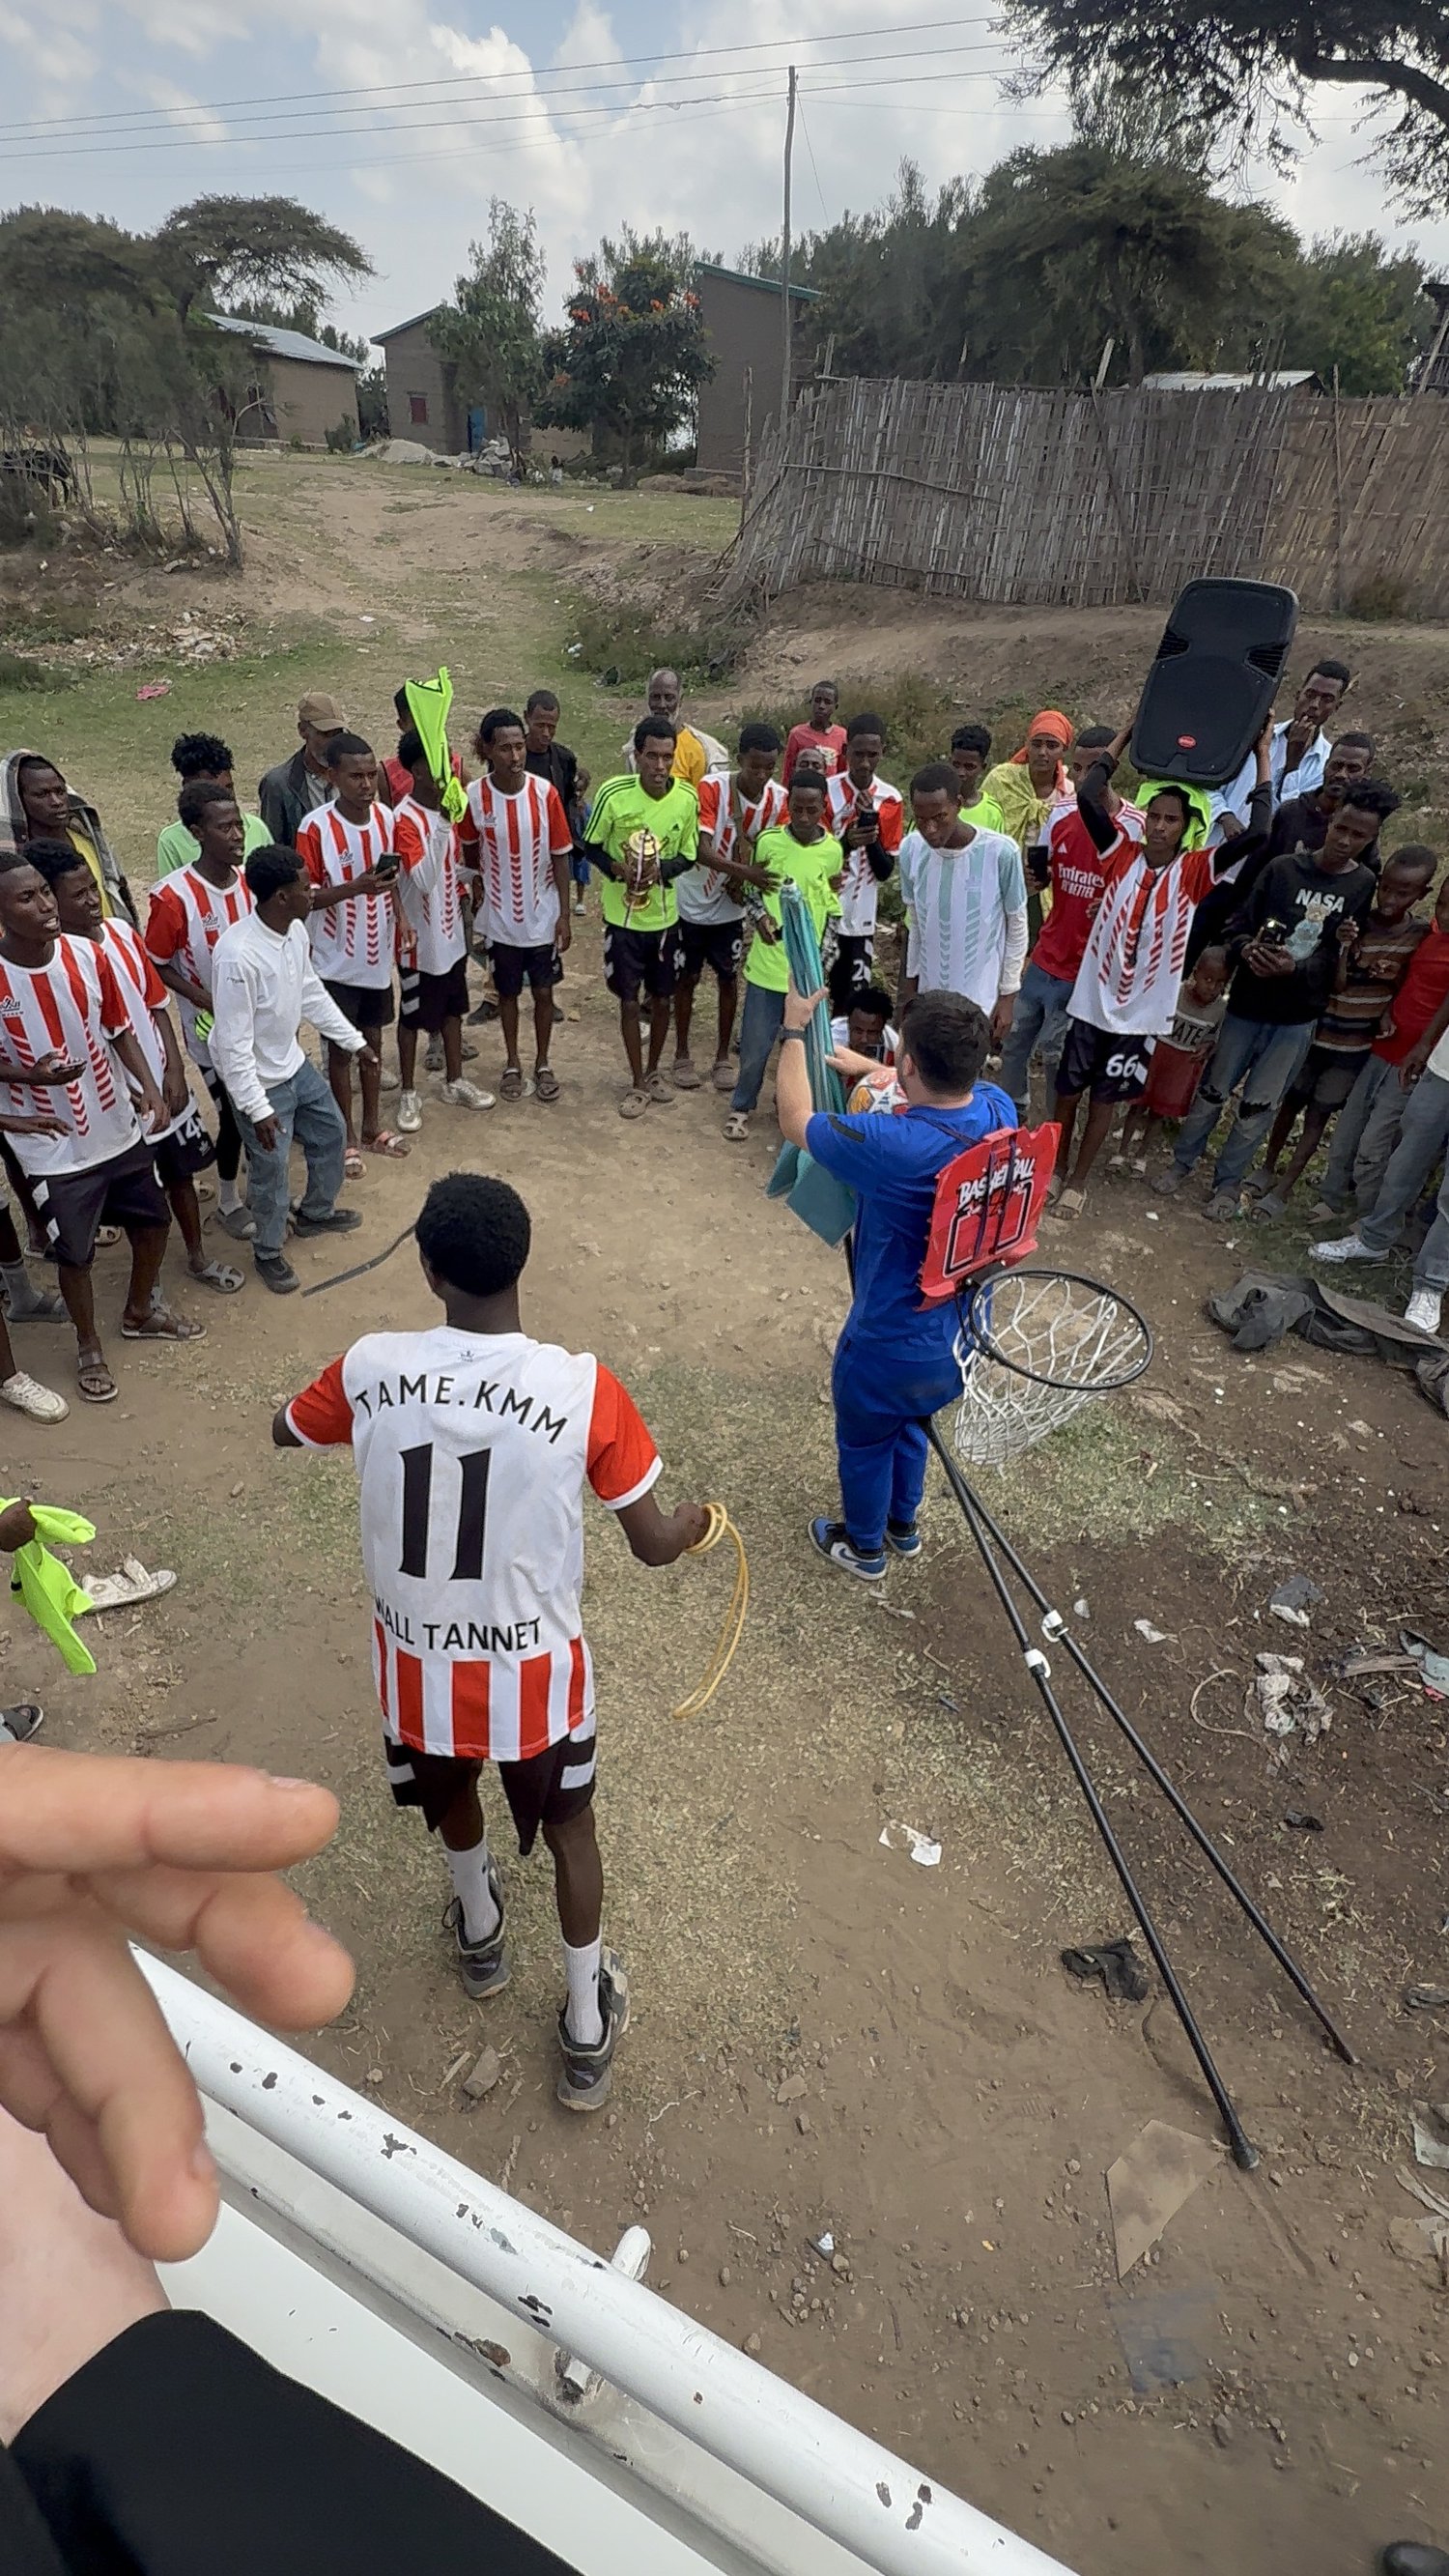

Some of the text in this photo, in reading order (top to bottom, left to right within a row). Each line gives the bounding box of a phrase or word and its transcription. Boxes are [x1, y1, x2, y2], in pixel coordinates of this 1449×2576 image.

[1058, 863, 1105, 888] Emirates
[1294, 888, 1346, 913] NASA
[1105, 1053, 1140, 1078] 66
[355, 1374, 569, 1445] TAME.KMM
[398, 1442, 493, 1582] 11
[374, 1594, 543, 1653] WALL TANNET
